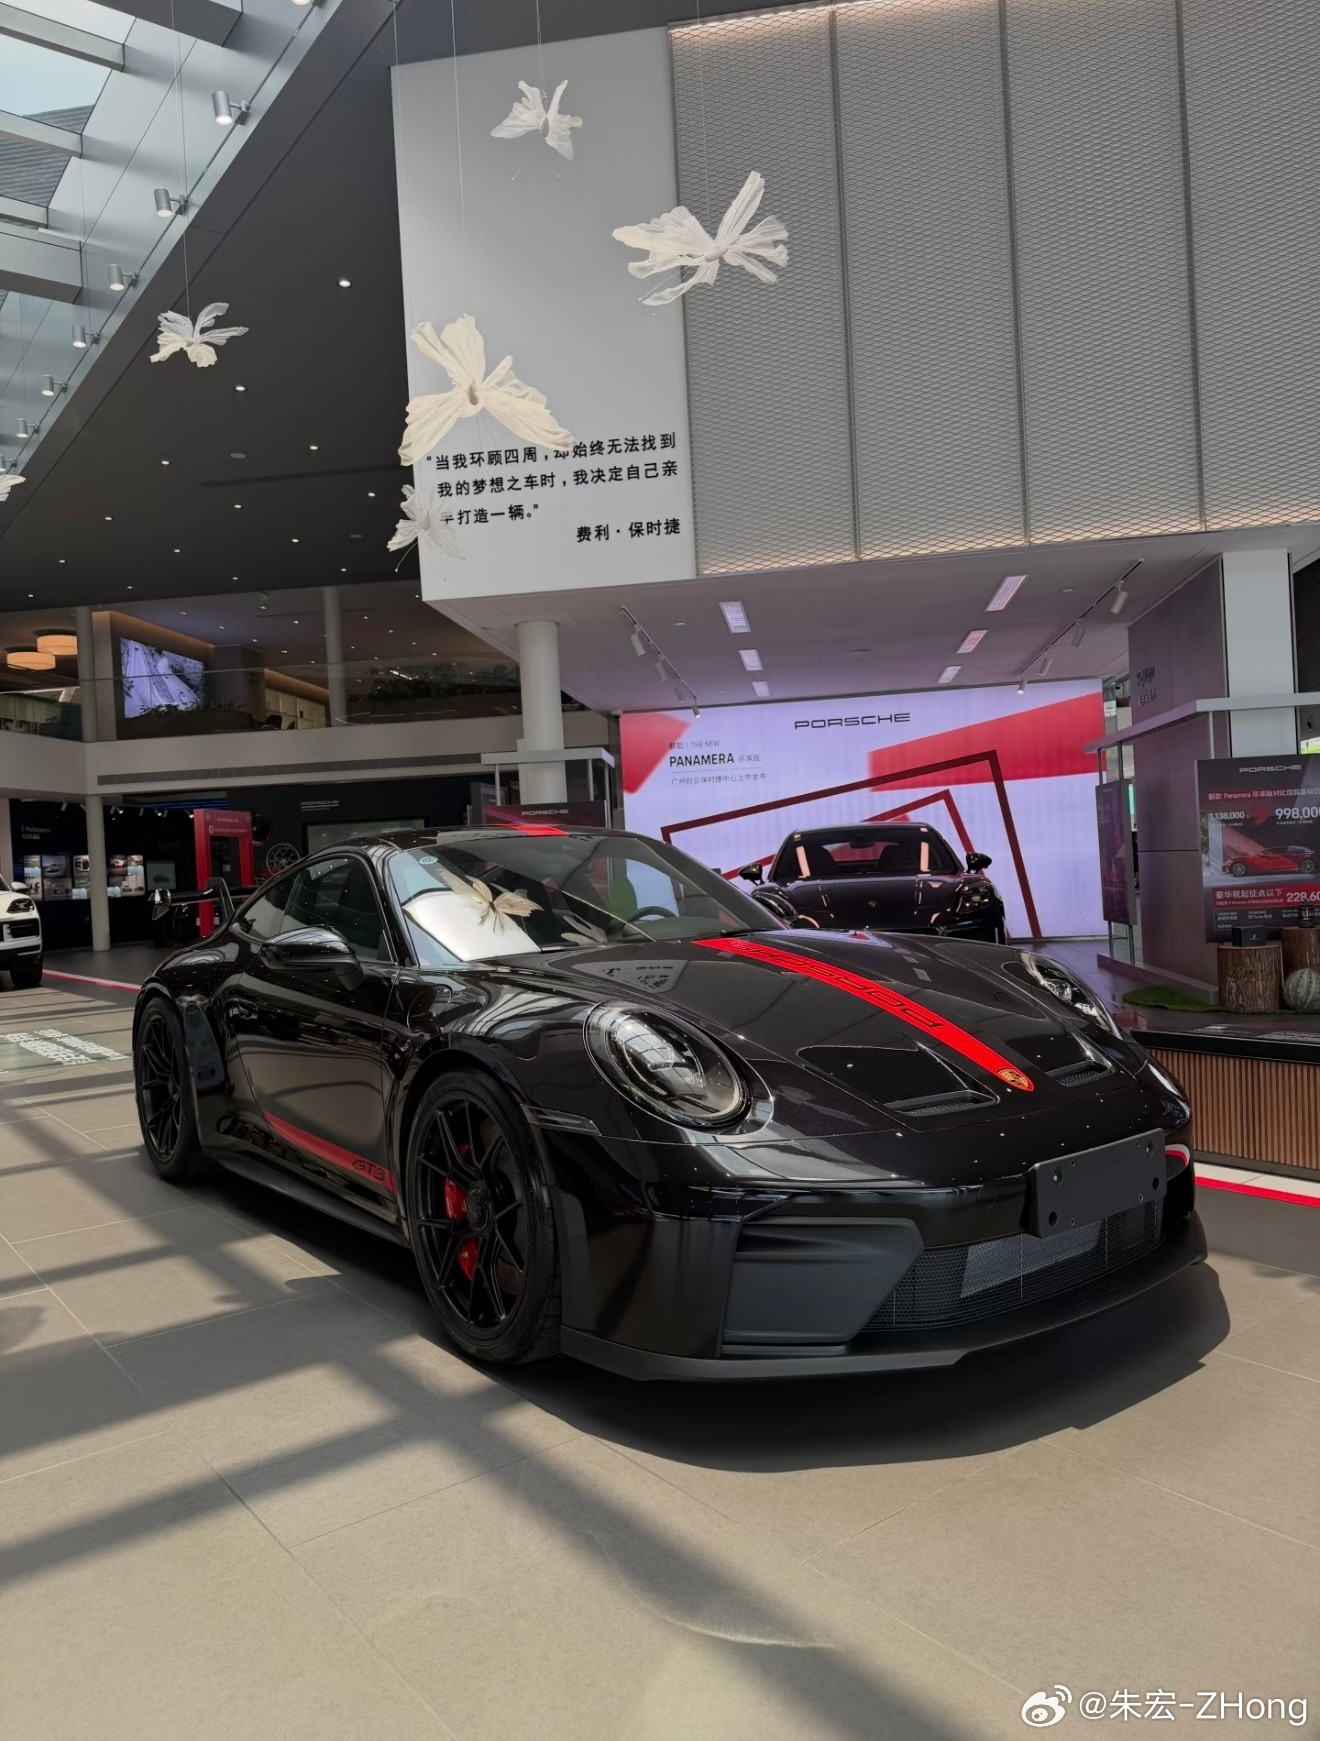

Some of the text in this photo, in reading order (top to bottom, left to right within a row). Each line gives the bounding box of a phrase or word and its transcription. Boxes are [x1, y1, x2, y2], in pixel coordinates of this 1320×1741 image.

[794, 712, 911, 730] PORSCHE
[704, 740, 720, 748] NEW
[669, 752, 735, 767] PANAMERA
[1239, 764, 1302, 773] PORSCHE
[1223, 791, 1251, 800] Panamera
[352, 1160, 386, 1181] GT3
